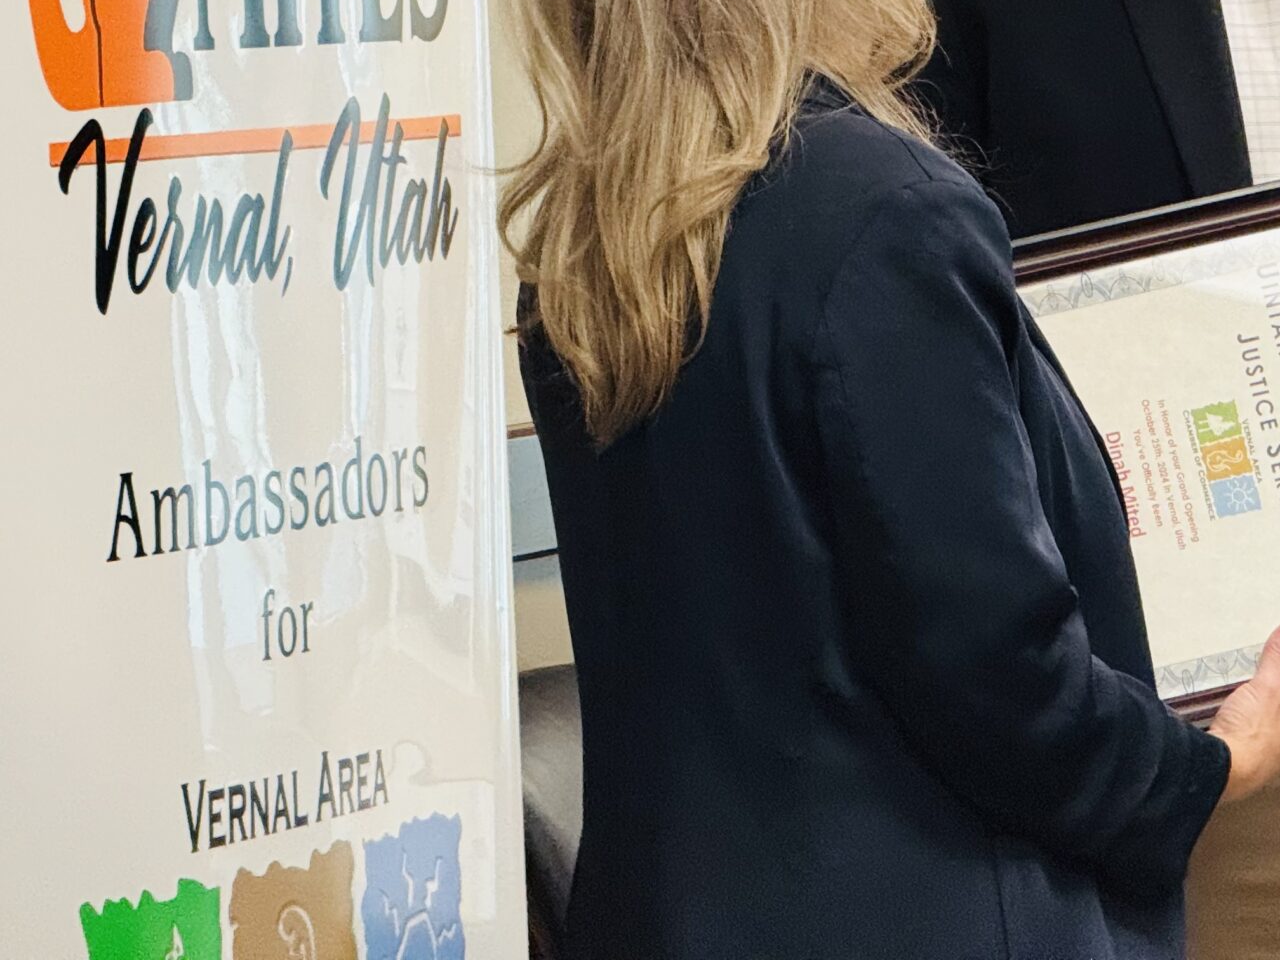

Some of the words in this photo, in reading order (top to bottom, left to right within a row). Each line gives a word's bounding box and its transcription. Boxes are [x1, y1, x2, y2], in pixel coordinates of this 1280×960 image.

[58, 108, 293, 315] Vernal,
[320, 93, 458, 292] Utah
[1157, 400, 1165, 408] In
[1237, 334, 1279, 431] JUSTICE
[1161, 410, 1172, 436] Honor
[1168, 439, 1178, 448] of
[1242, 419, 1255, 455] VERNAL
[1251, 459, 1262, 483] AREA
[1106, 431, 1131, 482] Dinah
[1122, 486, 1147, 538] Mited
[1133, 429, 1146, 460] You've
[1142, 462, 1156, 501] Officially
[1141, 400, 1156, 436] October
[1157, 462, 1169, 483] 2024
[1175, 529, 1186, 550] Utah
[1169, 450, 1181, 470] your
[1176, 472, 1191, 501] Grand
[1183, 410, 1199, 453] CHAMBER
[1198, 470, 1215, 521] COMMERCE
[107, 436, 429, 563] Ambassadors
[1184, 503, 1199, 542] Opening
[261, 589, 313, 661] for
[181, 770, 308, 853] VERNAL
[315, 749, 390, 823] AREA
